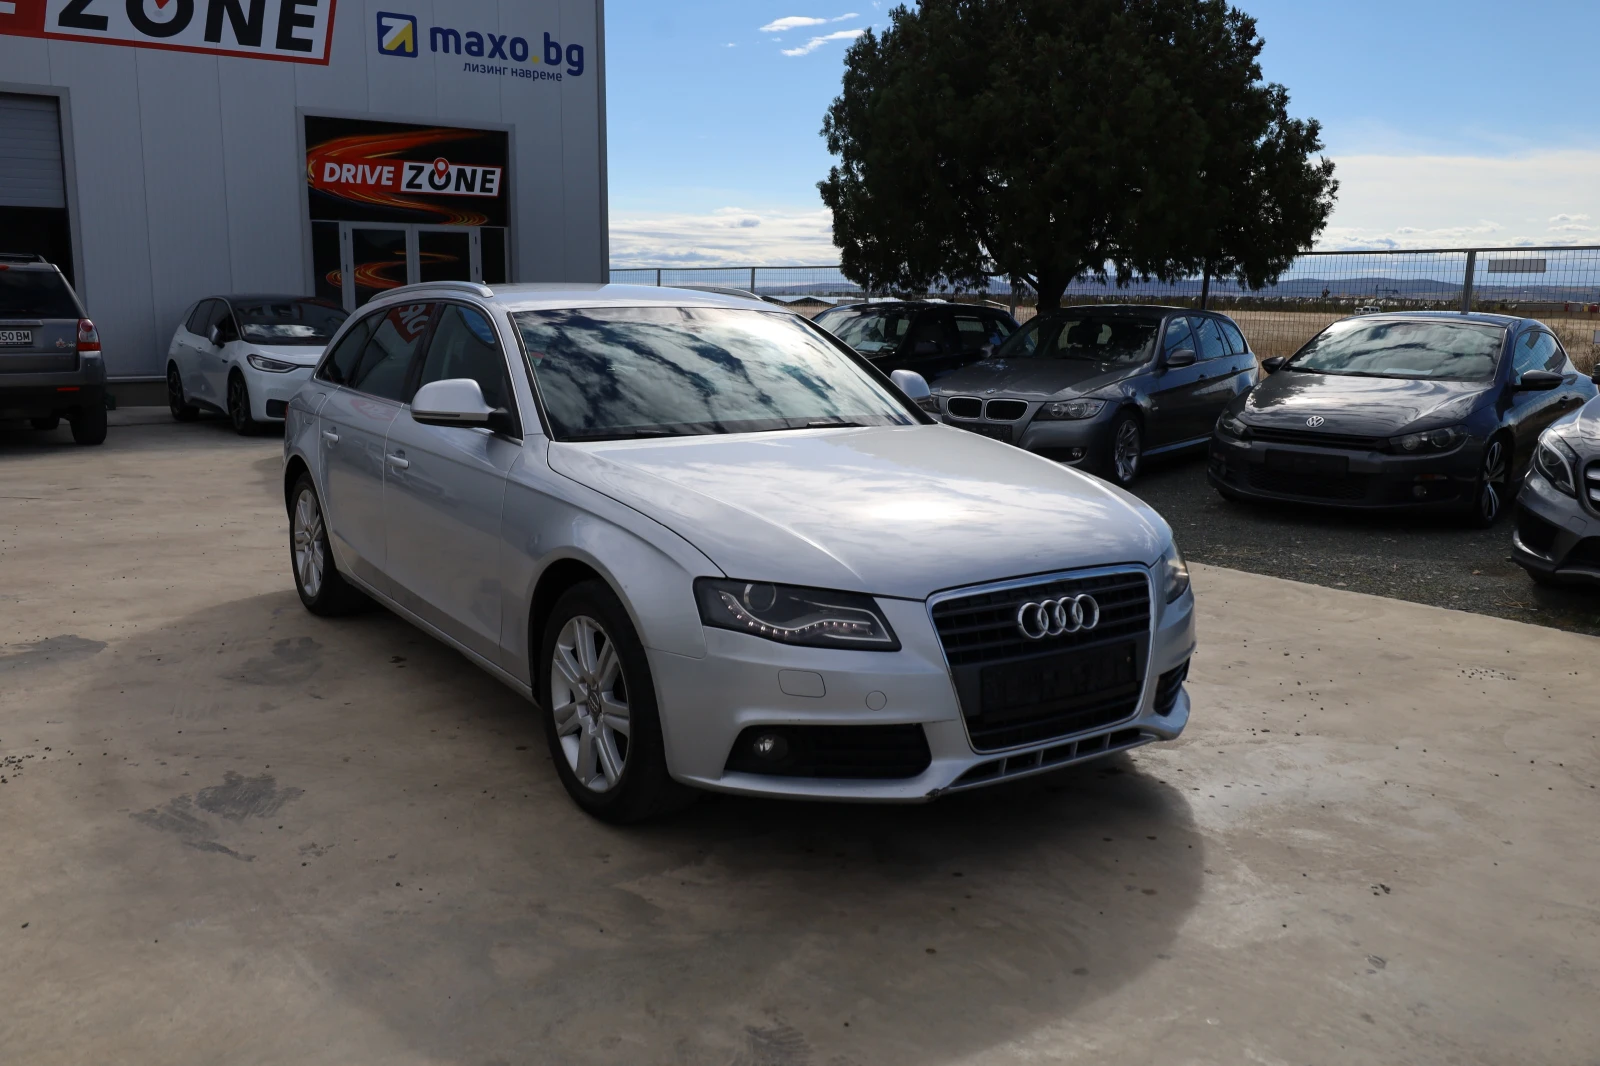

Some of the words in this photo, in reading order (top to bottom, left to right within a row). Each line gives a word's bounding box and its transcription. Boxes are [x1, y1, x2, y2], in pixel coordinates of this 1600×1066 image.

[429, 26, 585, 77] maxo.bg
[463, 61, 509, 76] лизинг
[510, 68, 563, 82] навреме
[323, 162, 395, 186] DRIVE
[405, 164, 496, 193] ZONE
